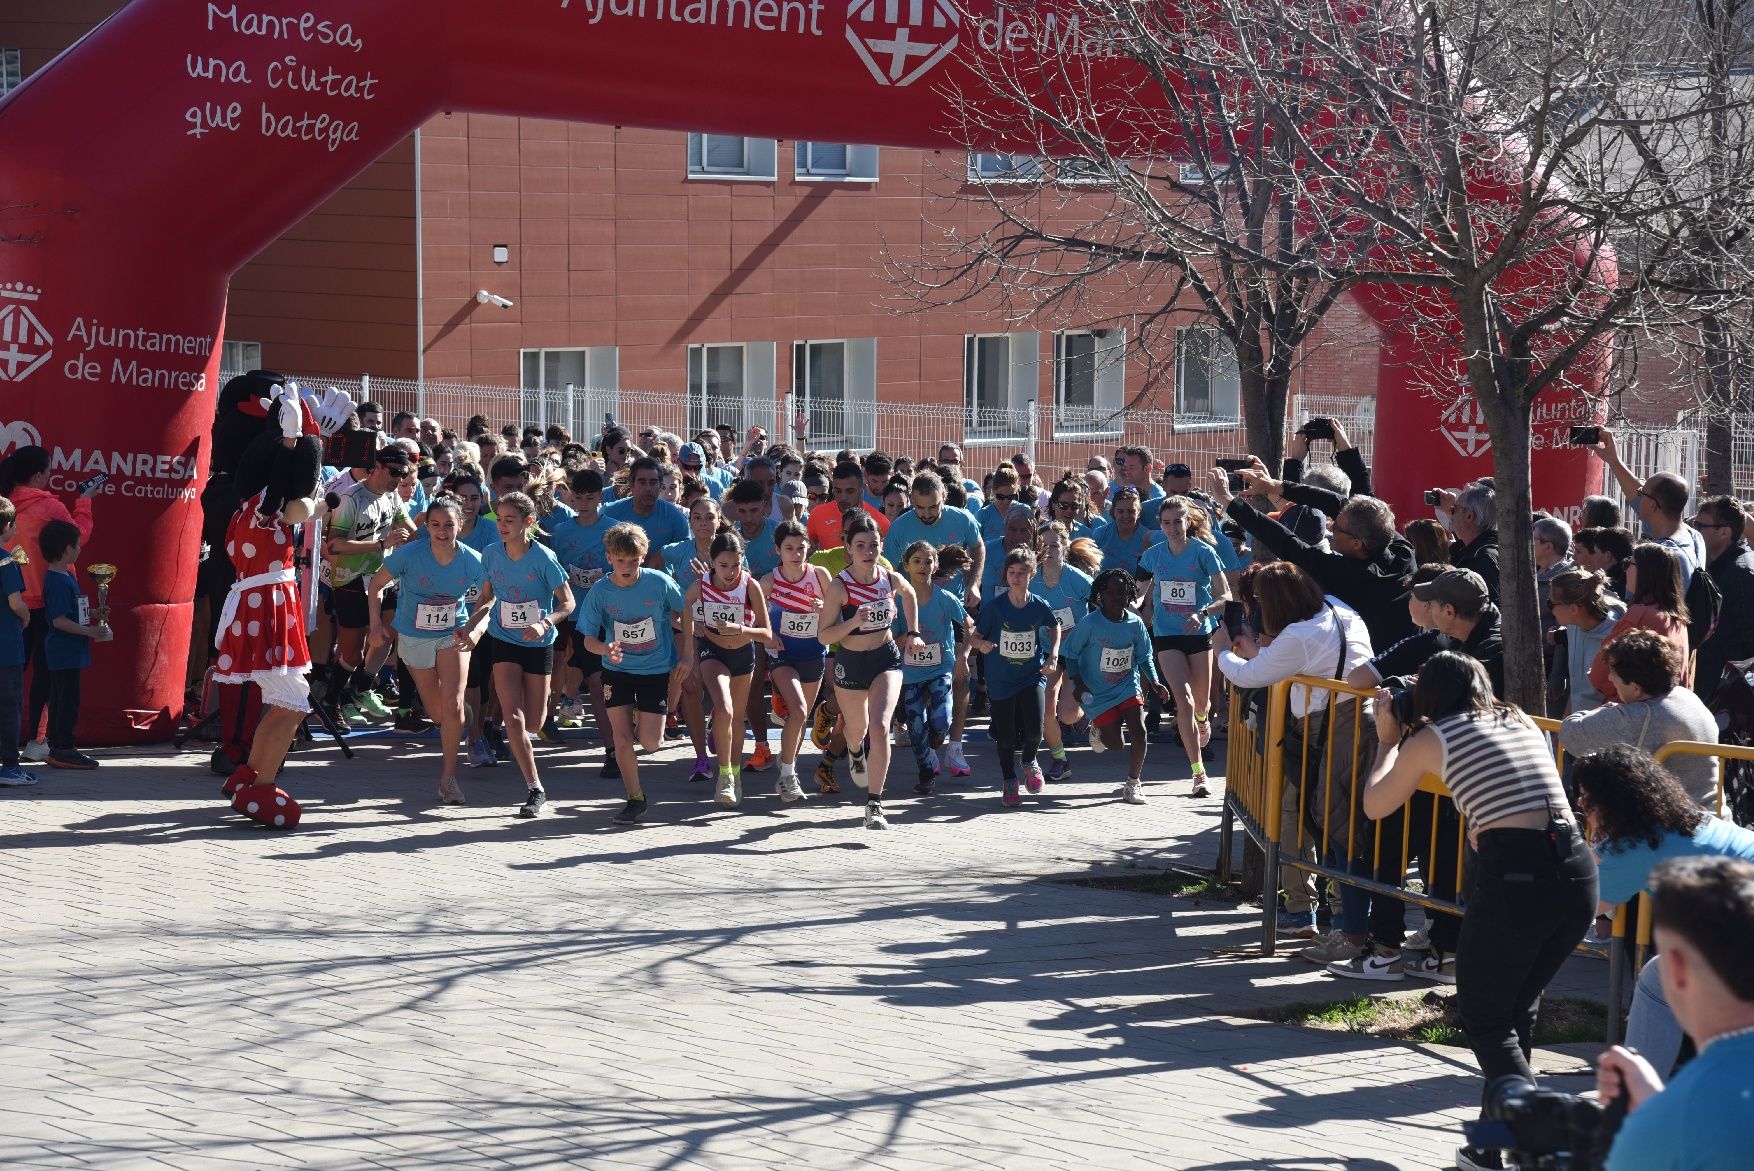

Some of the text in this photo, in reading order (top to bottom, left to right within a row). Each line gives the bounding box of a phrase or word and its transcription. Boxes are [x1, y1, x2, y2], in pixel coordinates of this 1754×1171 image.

[207, 2, 363, 52] Manresa,
[977, 6, 1029, 52] de
[186, 53, 379, 100] una ciutat
[184, 101, 360, 152] que batega
[66, 316, 212, 356] Ajuntament
[64, 353, 207, 392] de Manresa
[51, 446, 199, 480] MANRESA
[49, 474, 85, 492] Co
[120, 480, 197, 504] Catalunya
[1170, 587, 1185, 598] 80
[425, 612, 449, 624] 114
[511, 611, 527, 622] 54
[712, 611, 735, 623] 594
[787, 620, 811, 632] 367
[869, 608, 890, 623] 366
[622, 627, 646, 639] 657
[1003, 640, 1032, 652] 1033
